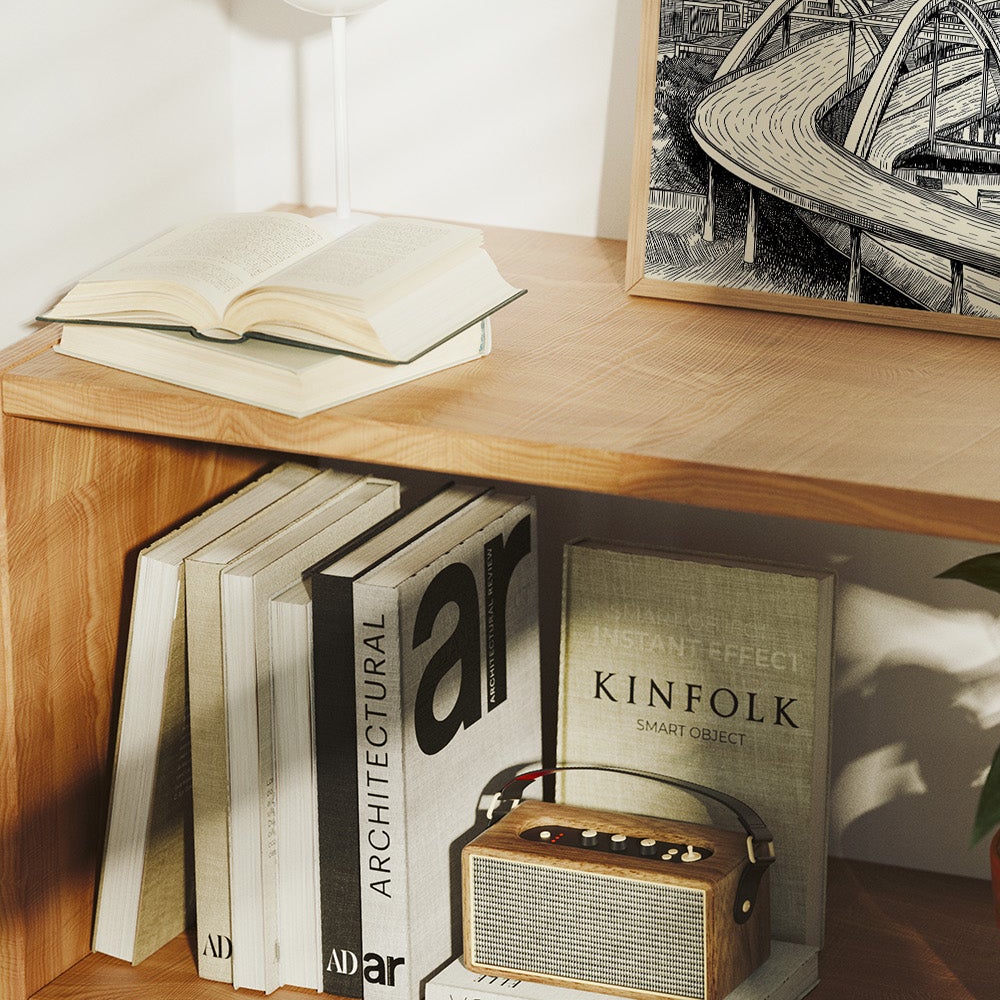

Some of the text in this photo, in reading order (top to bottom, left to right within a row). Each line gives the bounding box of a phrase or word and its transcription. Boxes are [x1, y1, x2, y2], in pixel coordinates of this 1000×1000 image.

[413, 514, 532, 756] ar
[486, 548, 498, 703] ARCHITECTURAL REVIEW
[593, 670, 800, 729] KINFOLK
[636, 718, 746, 746] SMART OBJECT
[360, 614, 392, 899] ARCHITECTURAL
[202, 933, 233, 960] AD
[326, 948, 358, 976] AD
[363, 951, 405, 987] ar
